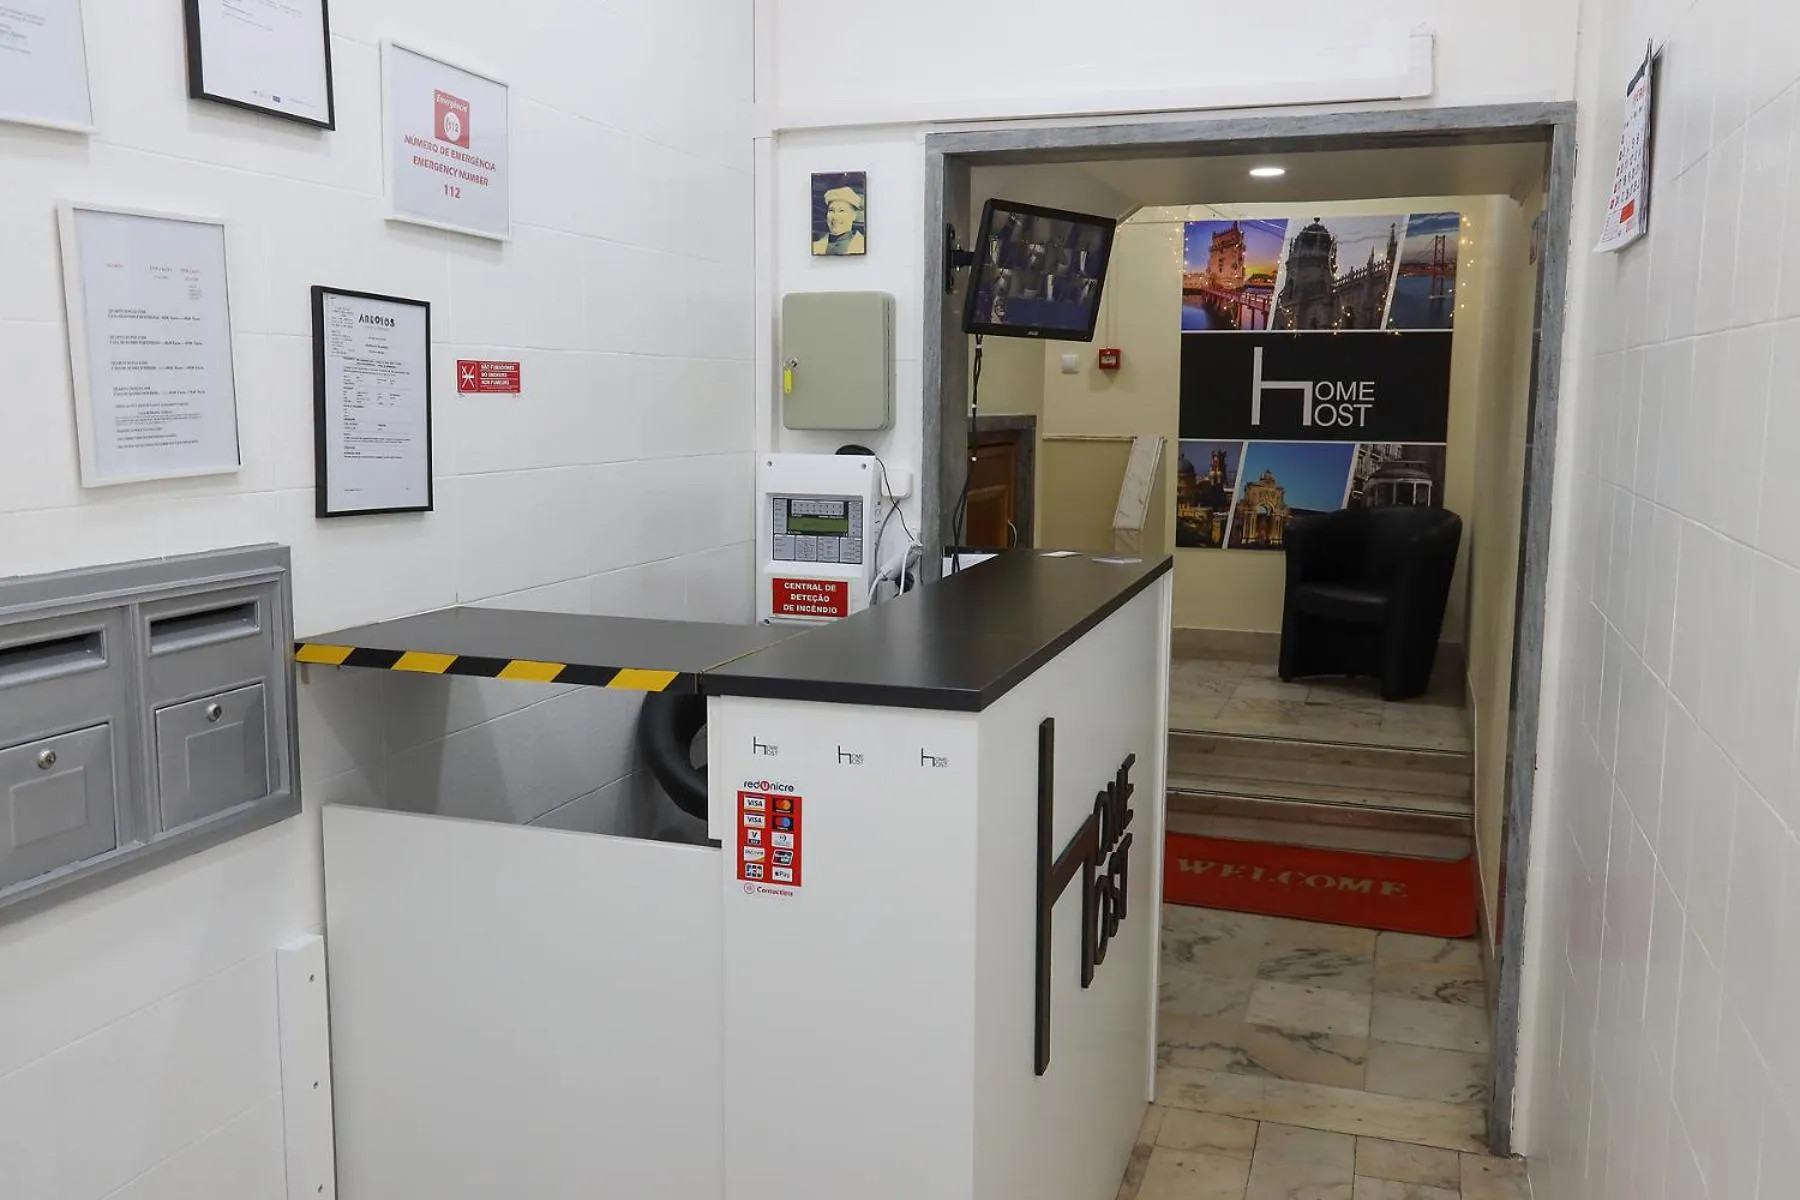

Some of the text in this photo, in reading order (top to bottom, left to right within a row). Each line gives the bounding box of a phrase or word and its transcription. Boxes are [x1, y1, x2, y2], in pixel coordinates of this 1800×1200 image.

[440, 145, 450, 156] DE
[413, 155, 489, 186] EMERGENCY NUMBER
[444, 184, 461, 199] 112
[784, 582, 837, 592] CENTRAL DE
[790, 593, 830, 603] DETEÇÃO
[783, 604, 795, 612] DE
[747, 799, 763, 807] VISA
[1177, 857, 1409, 897] WELCOME
